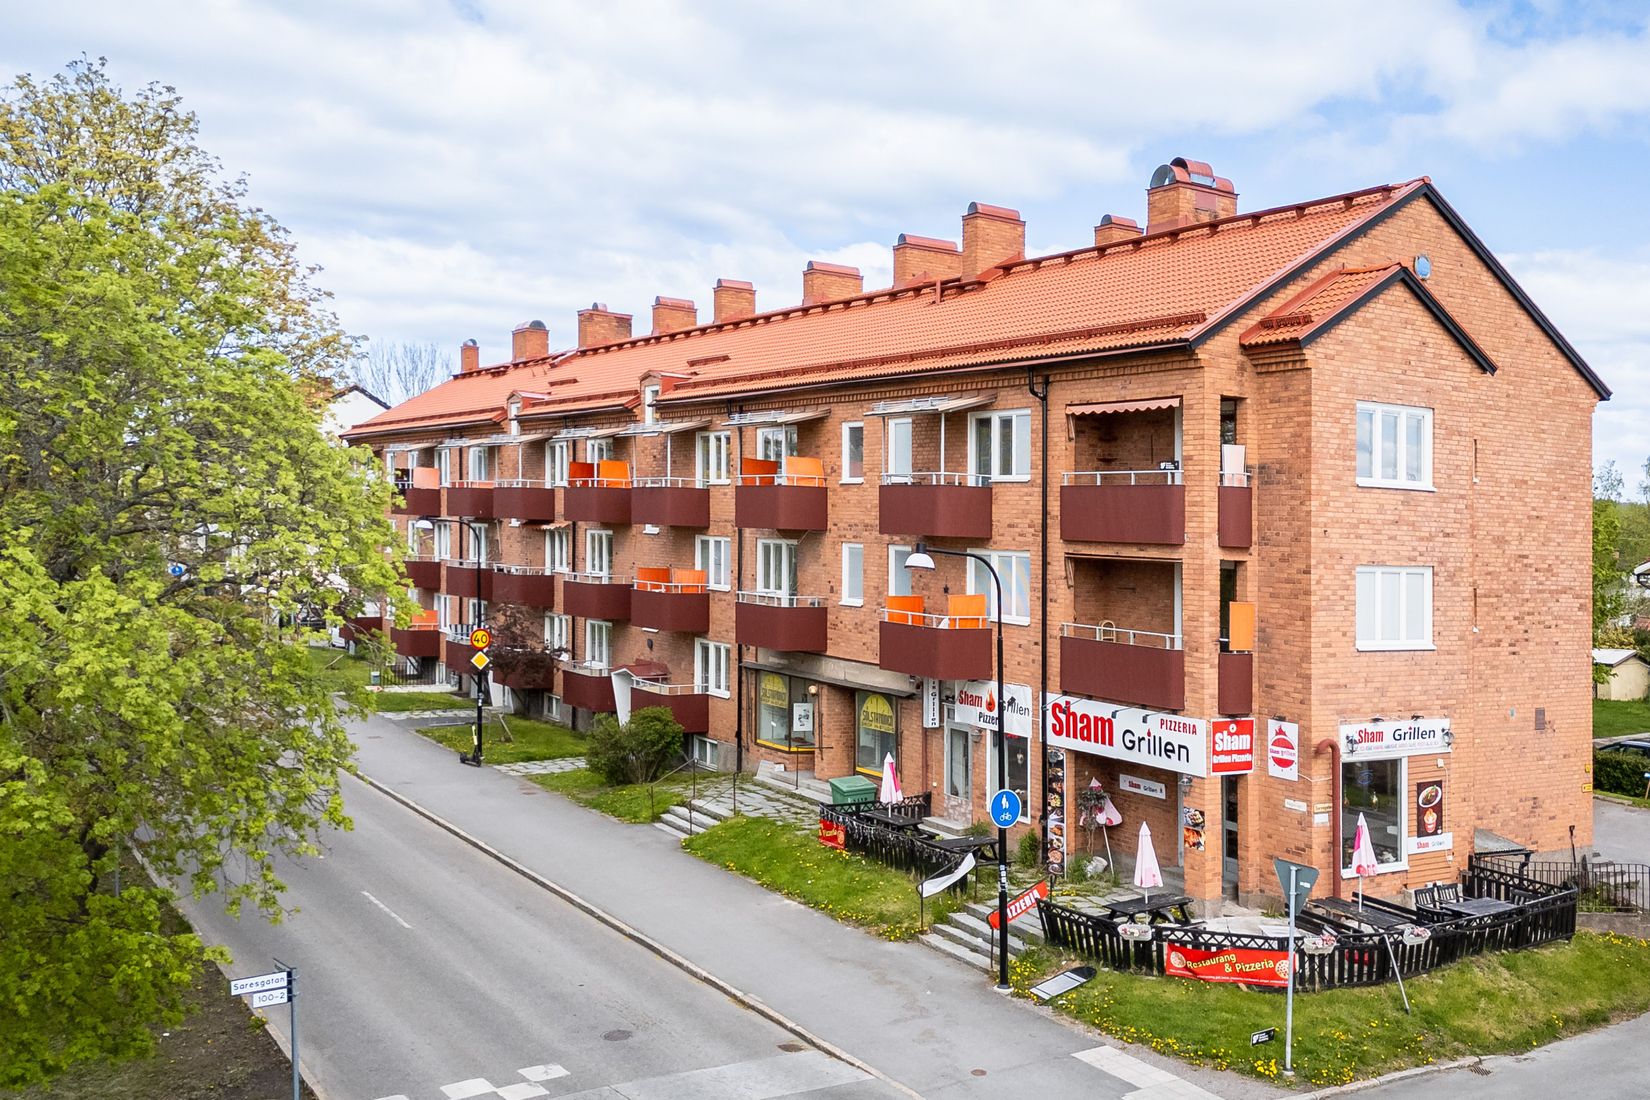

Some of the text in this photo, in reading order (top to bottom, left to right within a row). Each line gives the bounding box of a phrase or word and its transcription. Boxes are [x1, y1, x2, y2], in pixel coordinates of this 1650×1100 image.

[473, 634, 488, 644] 40
[958, 690, 983, 708] Sham
[978, 711, 999, 725] Pizzer
[1159, 718, 1197, 735] PIZZERIA
[1051, 700, 1190, 763] Sham Grillen
[1358, 726, 1436, 744] Sham Grillen
[1214, 730, 1251, 752] Sham
[1007, 888, 1041, 919] IZZERIA
[1186, 953, 1237, 969] Restaurang
[1224, 958, 1275, 973] & Pizzeria
[258, 991, 285, 1003] 100-2
